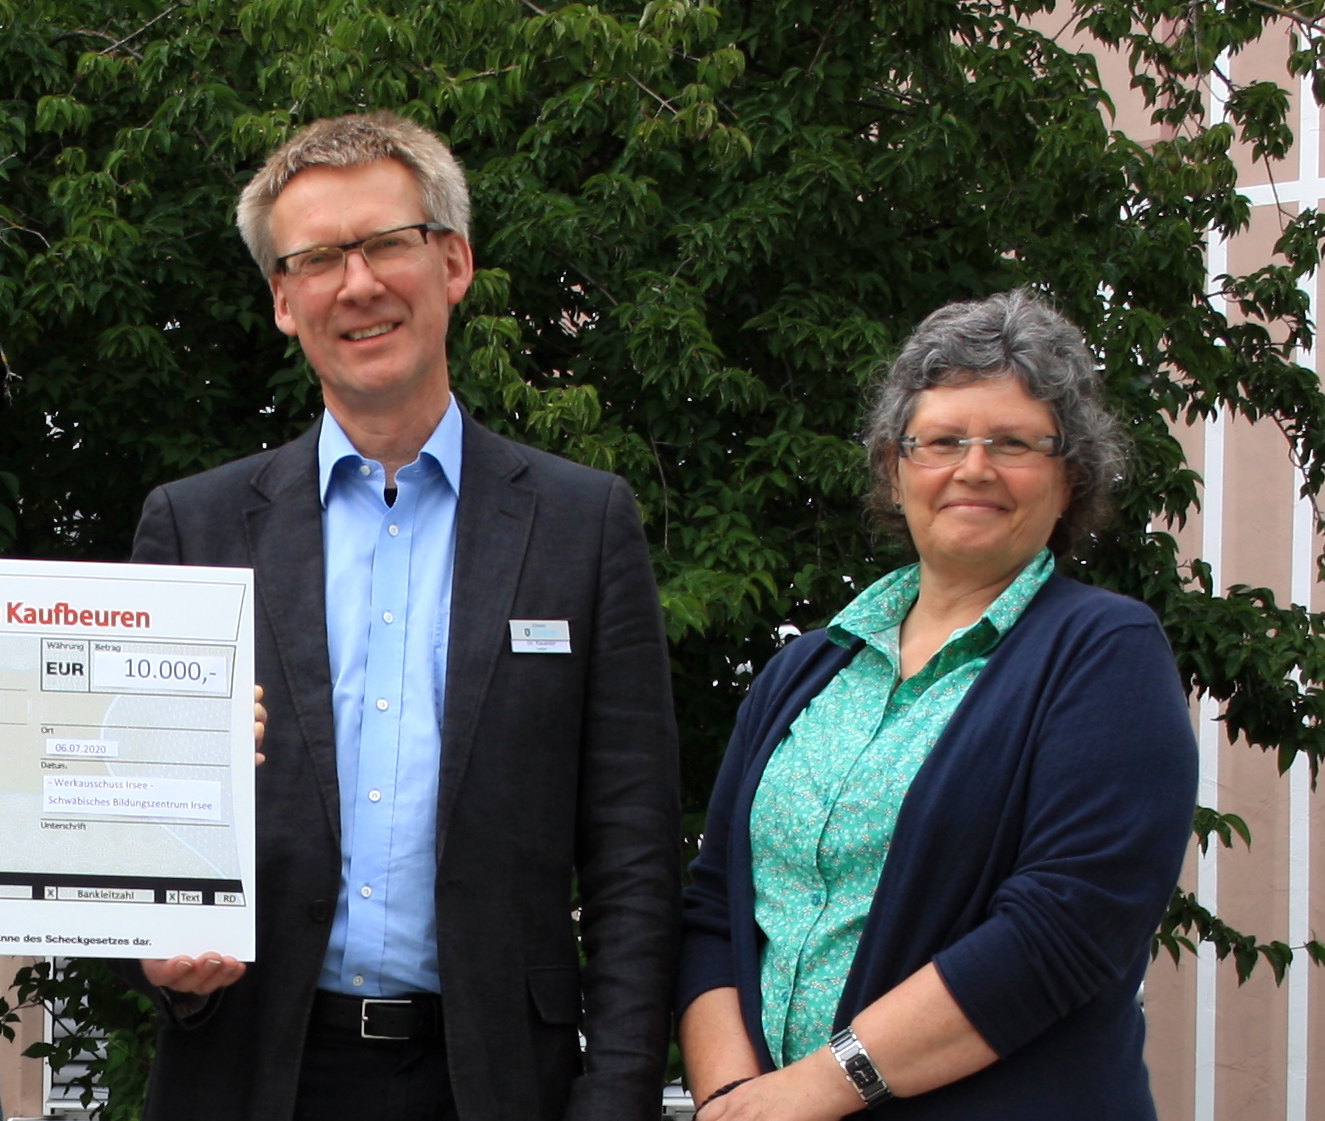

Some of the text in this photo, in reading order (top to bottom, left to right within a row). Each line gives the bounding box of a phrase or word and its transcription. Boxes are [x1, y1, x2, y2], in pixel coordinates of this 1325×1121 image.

[7, 601, 151, 629] Kaufbeuren
[46, 641, 84, 652] Währung
[95, 644, 121, 653] Betrag
[46, 661, 84, 676] EUR
[125, 658, 217, 685] 10.000,-
[41, 727, 54, 735] Ort
[55, 743, 107, 754] 06.07.2020
[54, 778, 124, 790] Werkausschuss
[126, 781, 149, 790] Irsee
[113, 798, 188, 810] Bildungszentrum
[191, 801, 213, 811] Irsee
[41, 821, 87, 831] Unterschrift
[77, 890, 135, 900] Bankleitzahl
[181, 893, 200, 903] Text
[223, 894, 237, 903] RD
[23, 934, 42, 943] des
[45, 934, 130, 946] Scheckgesetzes
[133, 936, 152, 946] dar.
